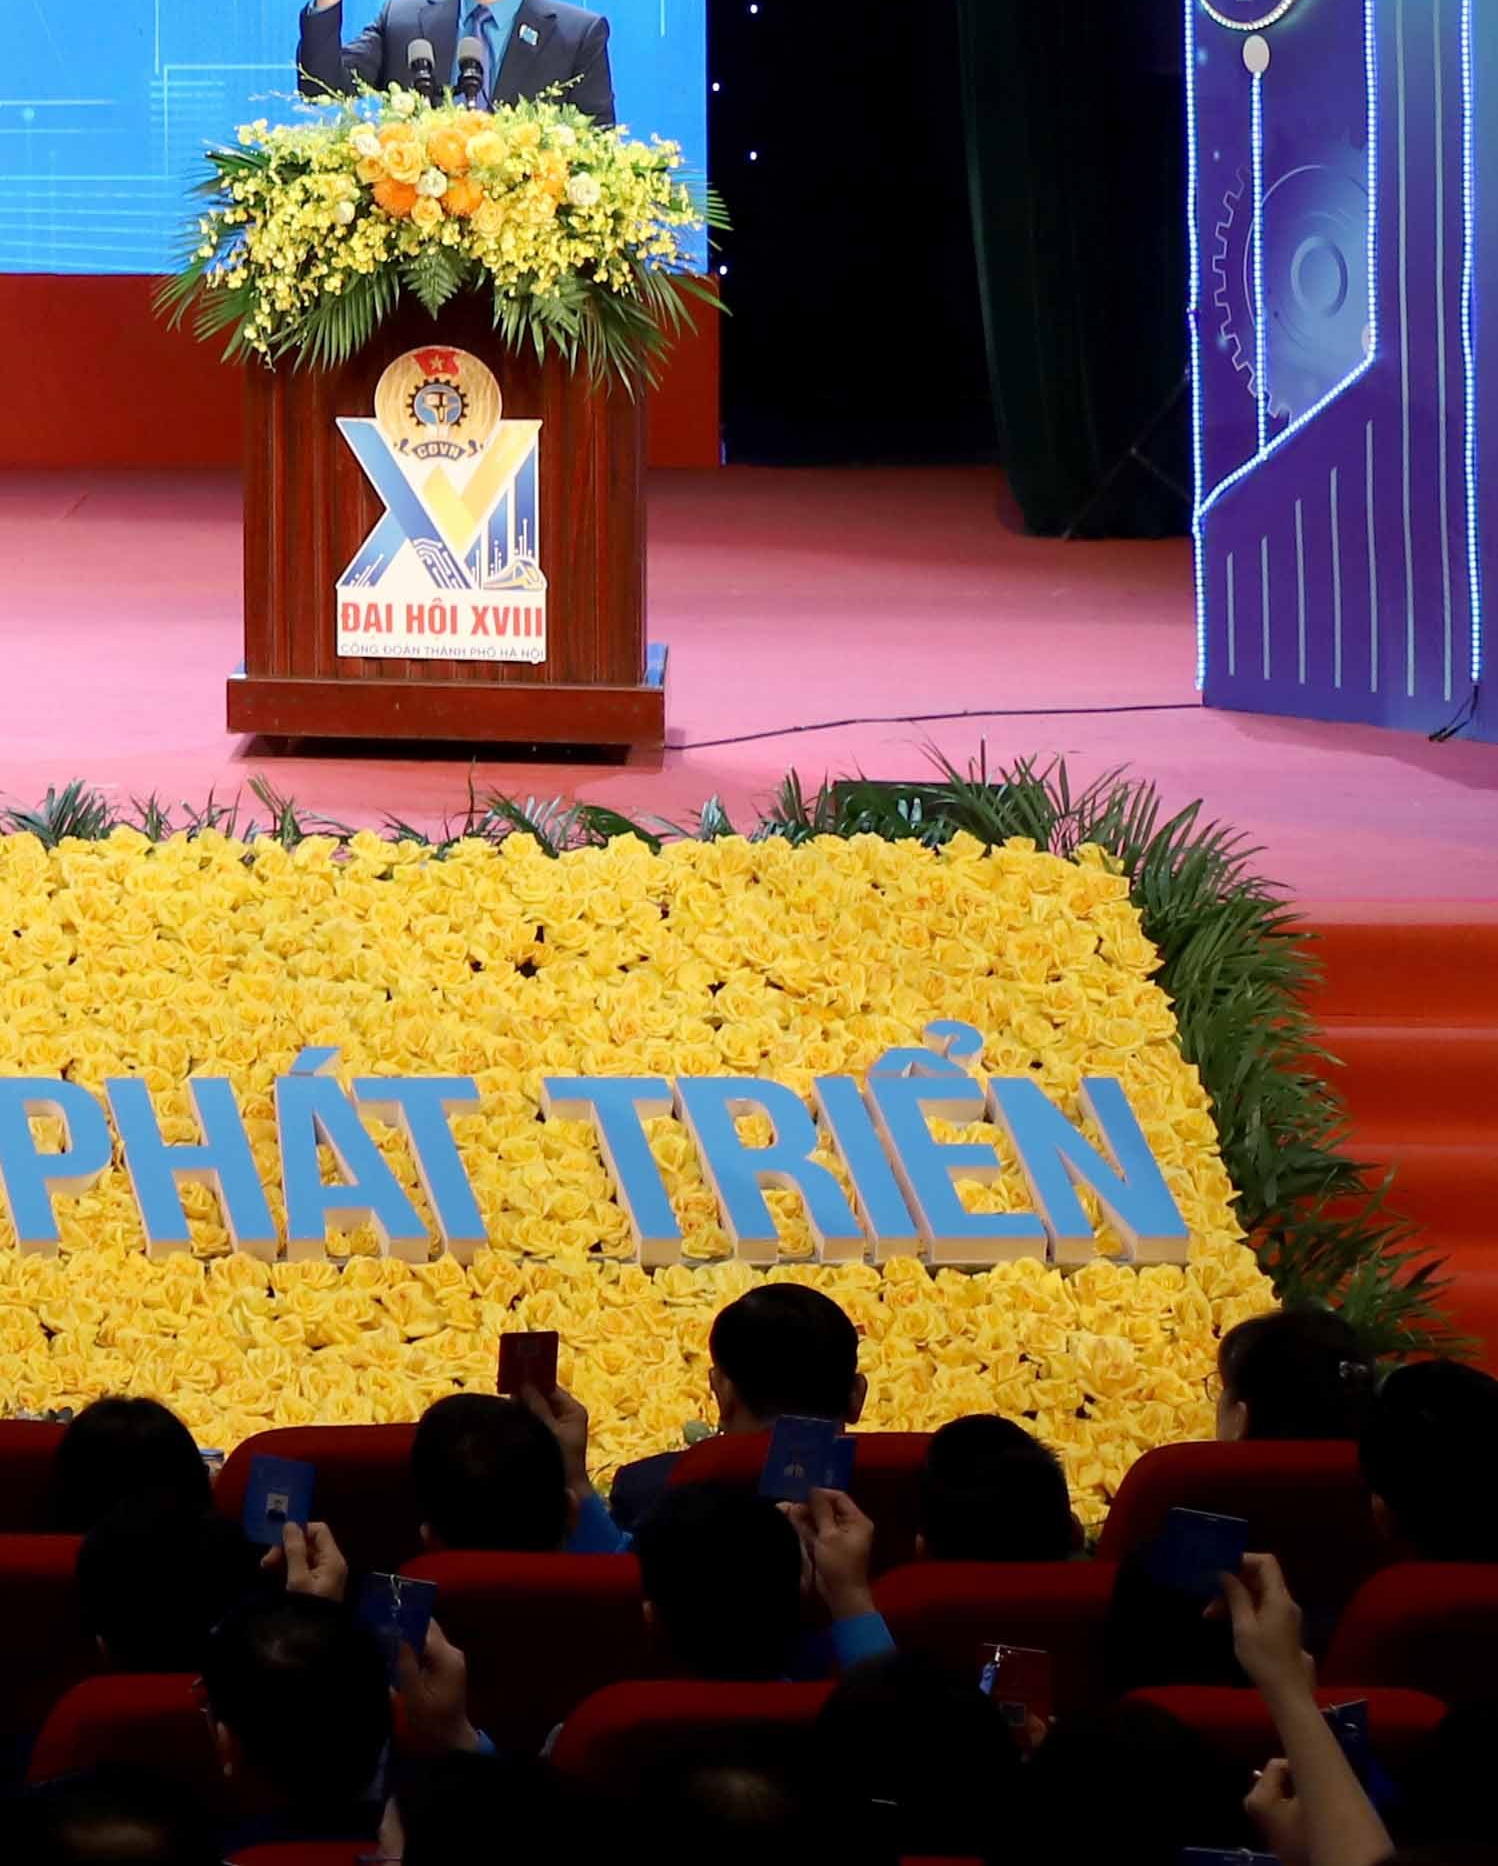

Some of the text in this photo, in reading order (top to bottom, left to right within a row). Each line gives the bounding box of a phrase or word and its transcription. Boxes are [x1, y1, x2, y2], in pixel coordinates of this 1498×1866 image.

[340, 597, 544, 642] ĐẠI HỘI XVIII
[340, 642, 380, 656] CÔNG
[383, 643, 421, 657] ĐOÀN
[423, 644, 467, 658] THÀNH
[500, 646, 519, 659] HÀ
[540, 1017, 1194, 1248] TRIỂN
